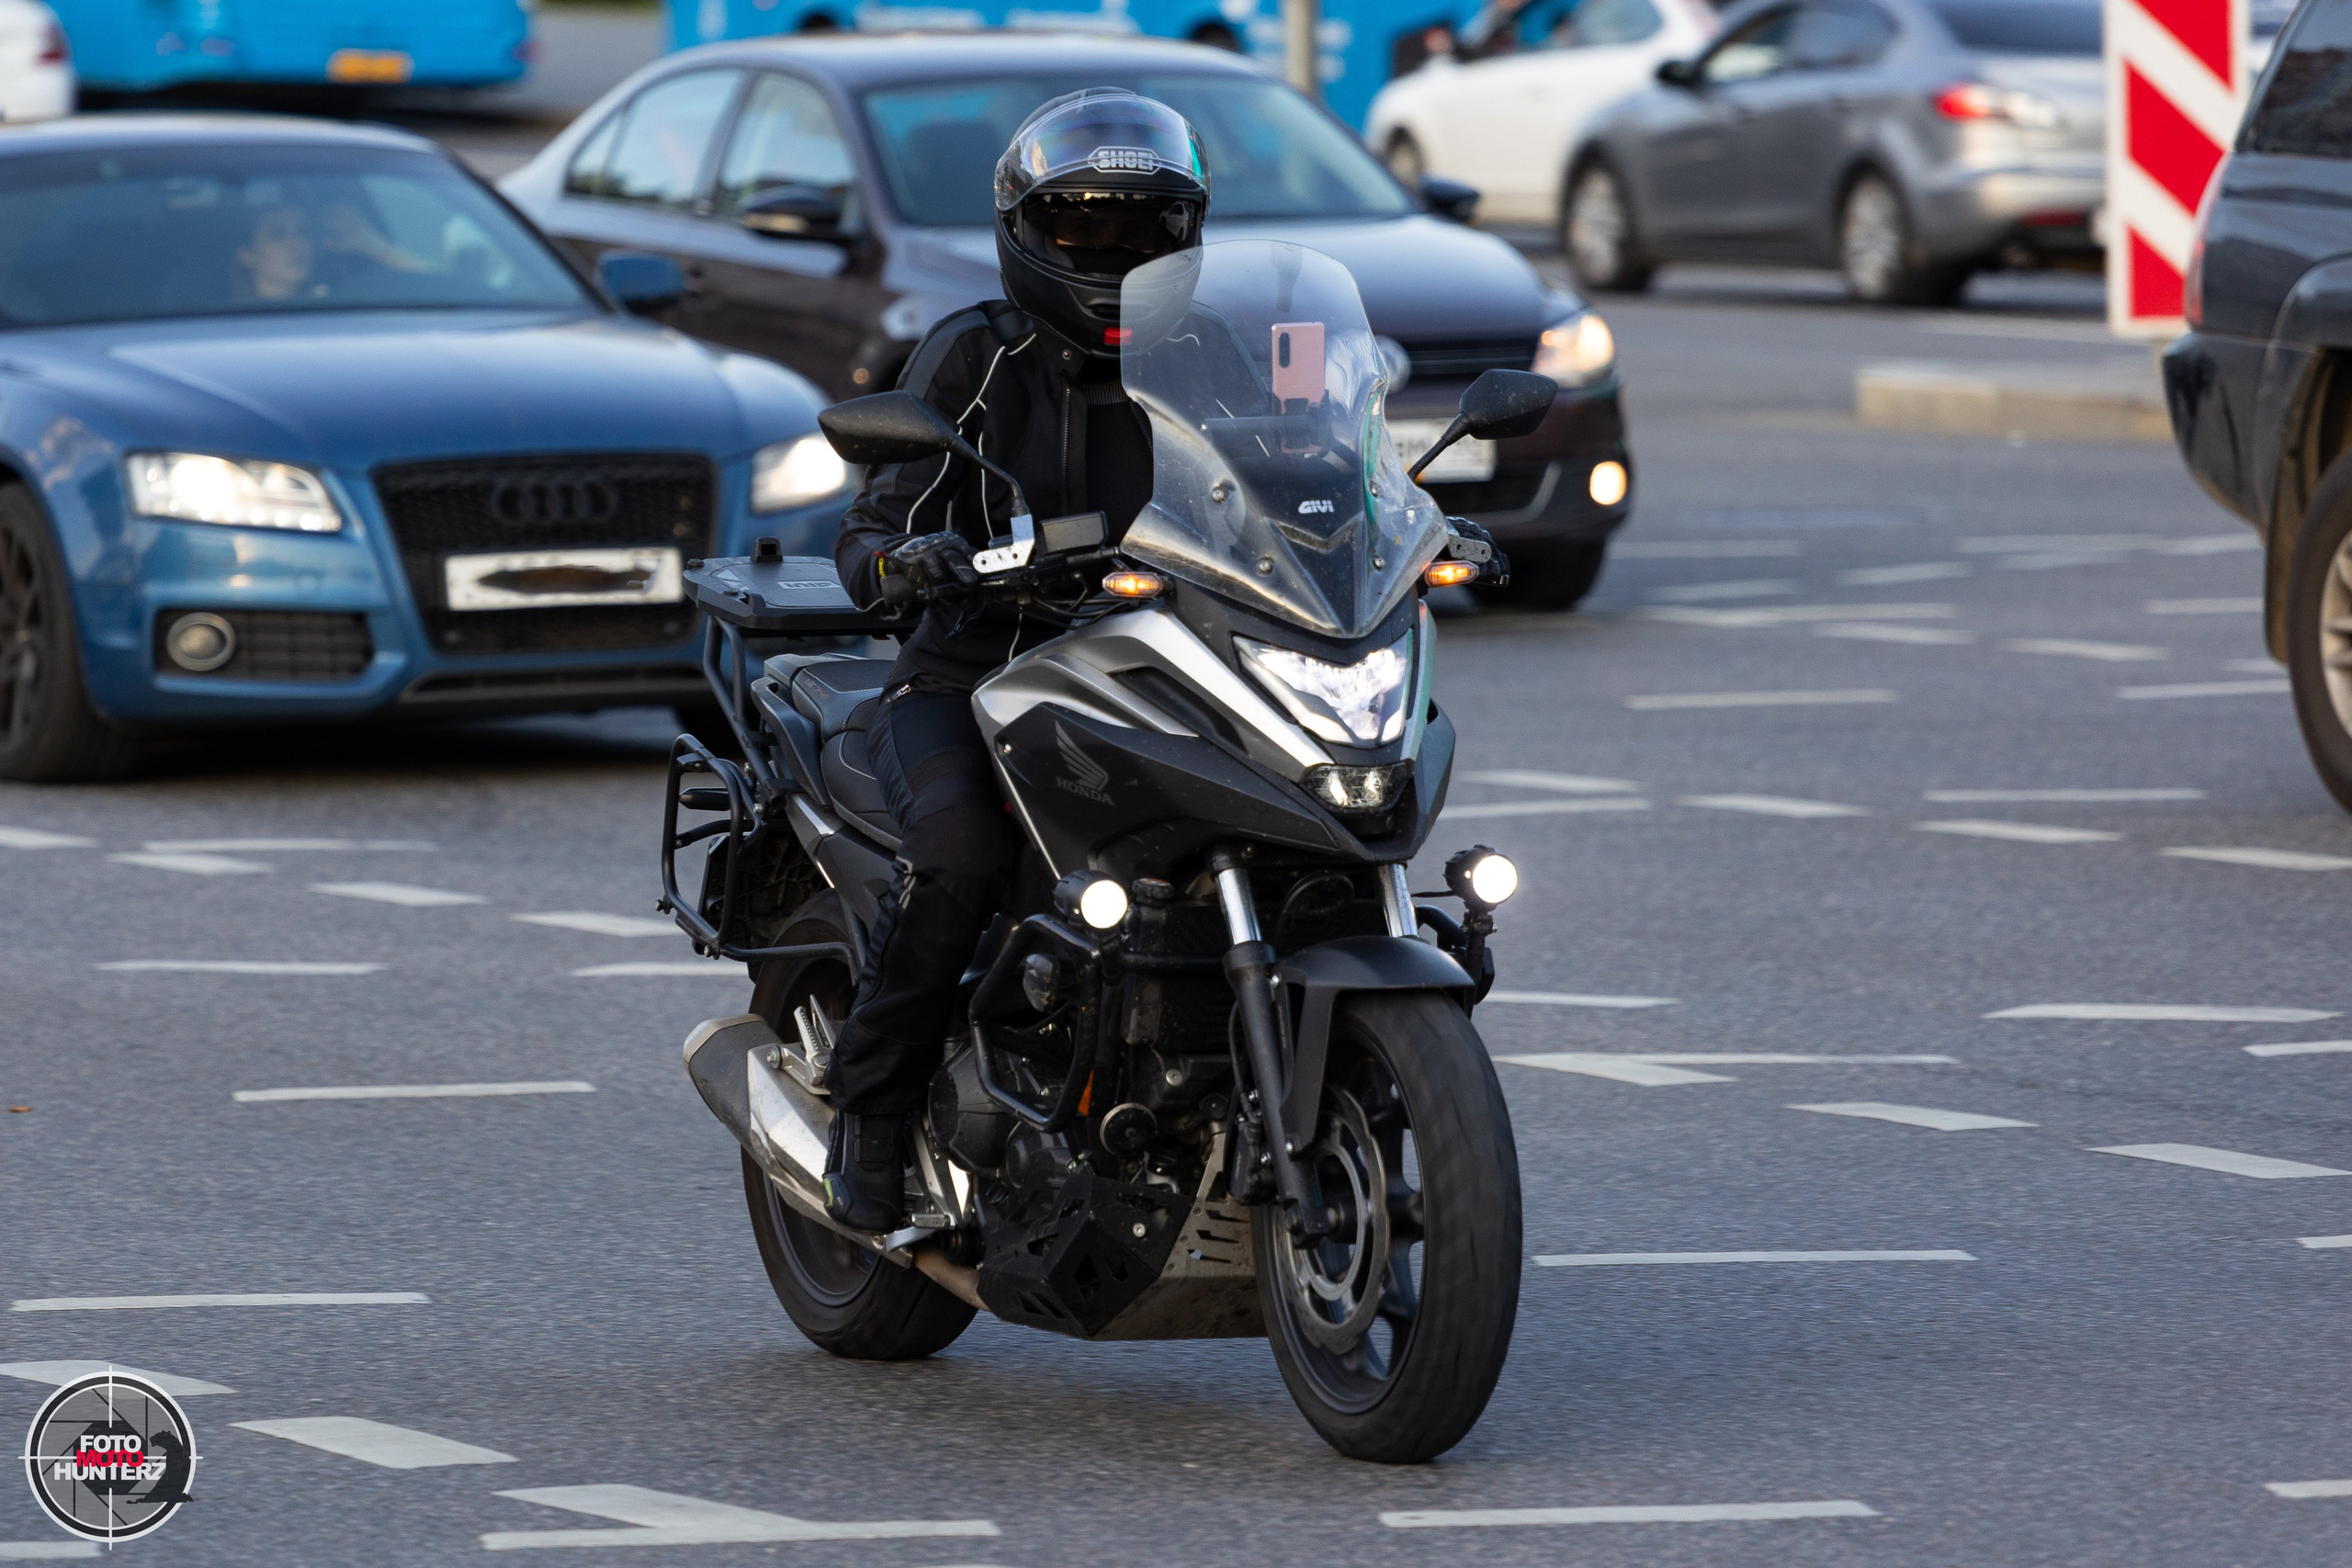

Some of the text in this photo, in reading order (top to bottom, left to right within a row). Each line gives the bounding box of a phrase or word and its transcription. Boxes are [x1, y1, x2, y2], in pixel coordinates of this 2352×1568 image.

[1098, 151, 1153, 171] SHOEI
[1297, 500, 1334, 514] GIVI
[1055, 776, 1114, 806] HONDA
